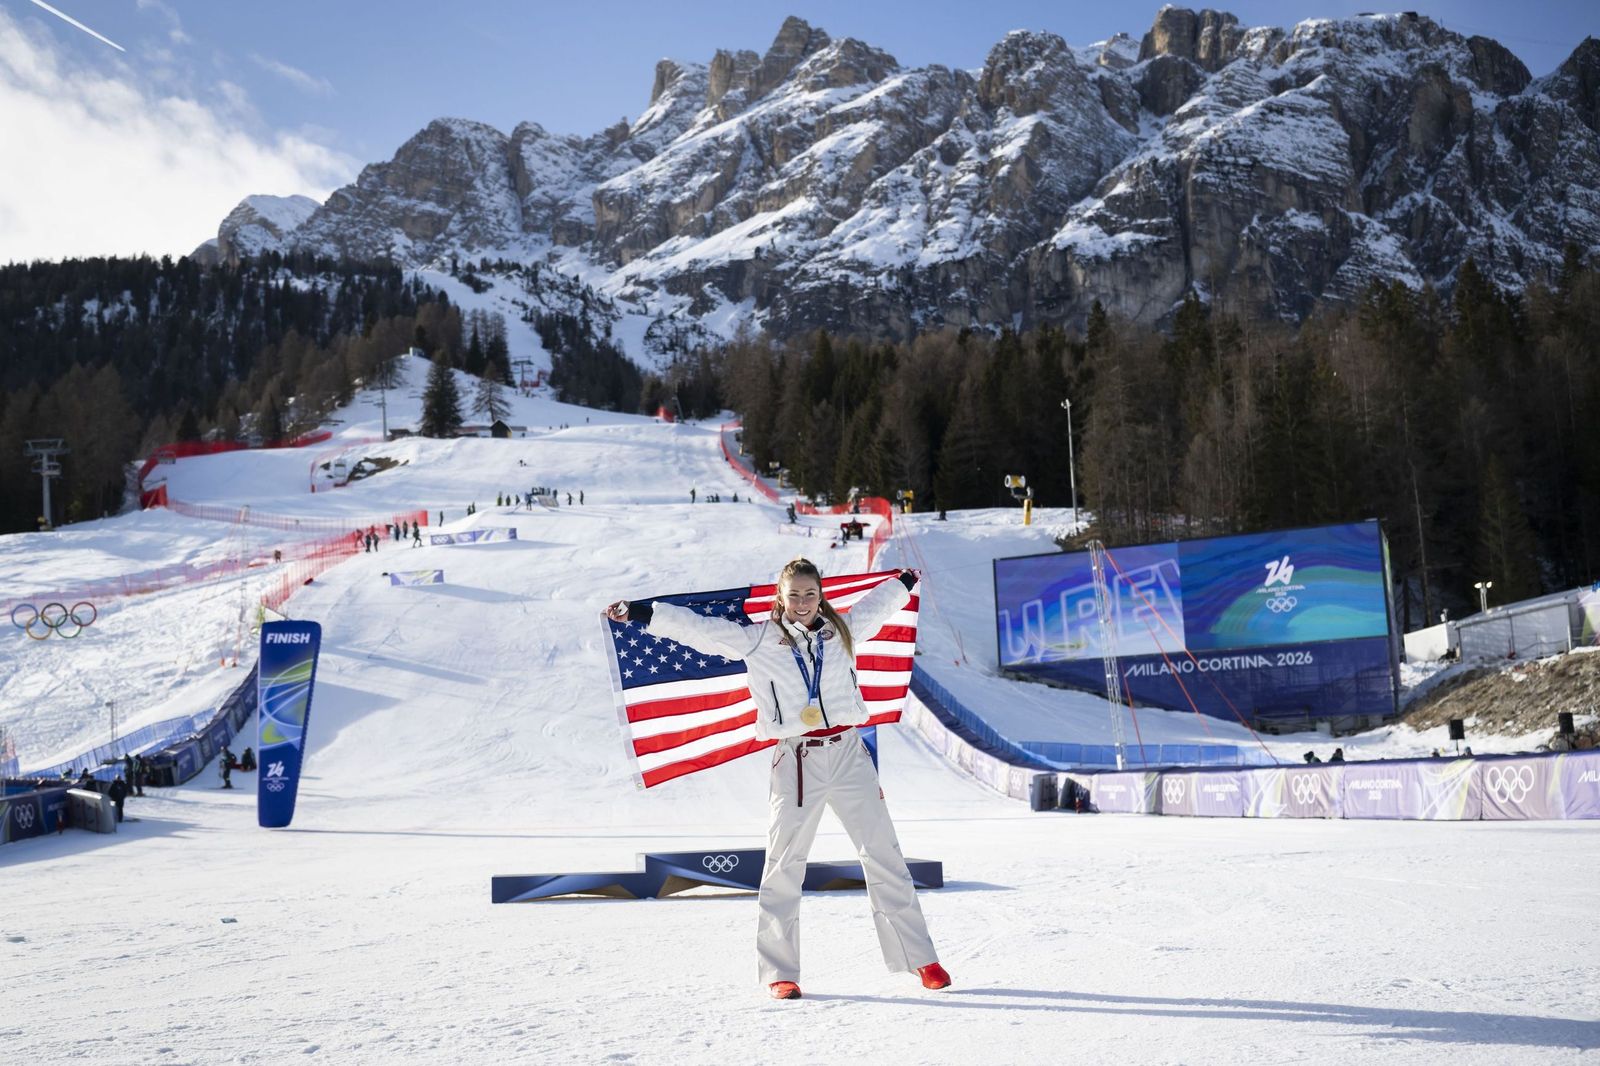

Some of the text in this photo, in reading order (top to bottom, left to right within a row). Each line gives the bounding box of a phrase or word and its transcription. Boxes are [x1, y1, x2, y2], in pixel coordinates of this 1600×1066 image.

[266, 632, 311, 645] FINISH
[1124, 651, 1314, 678] MILANO CORTINA 2026
